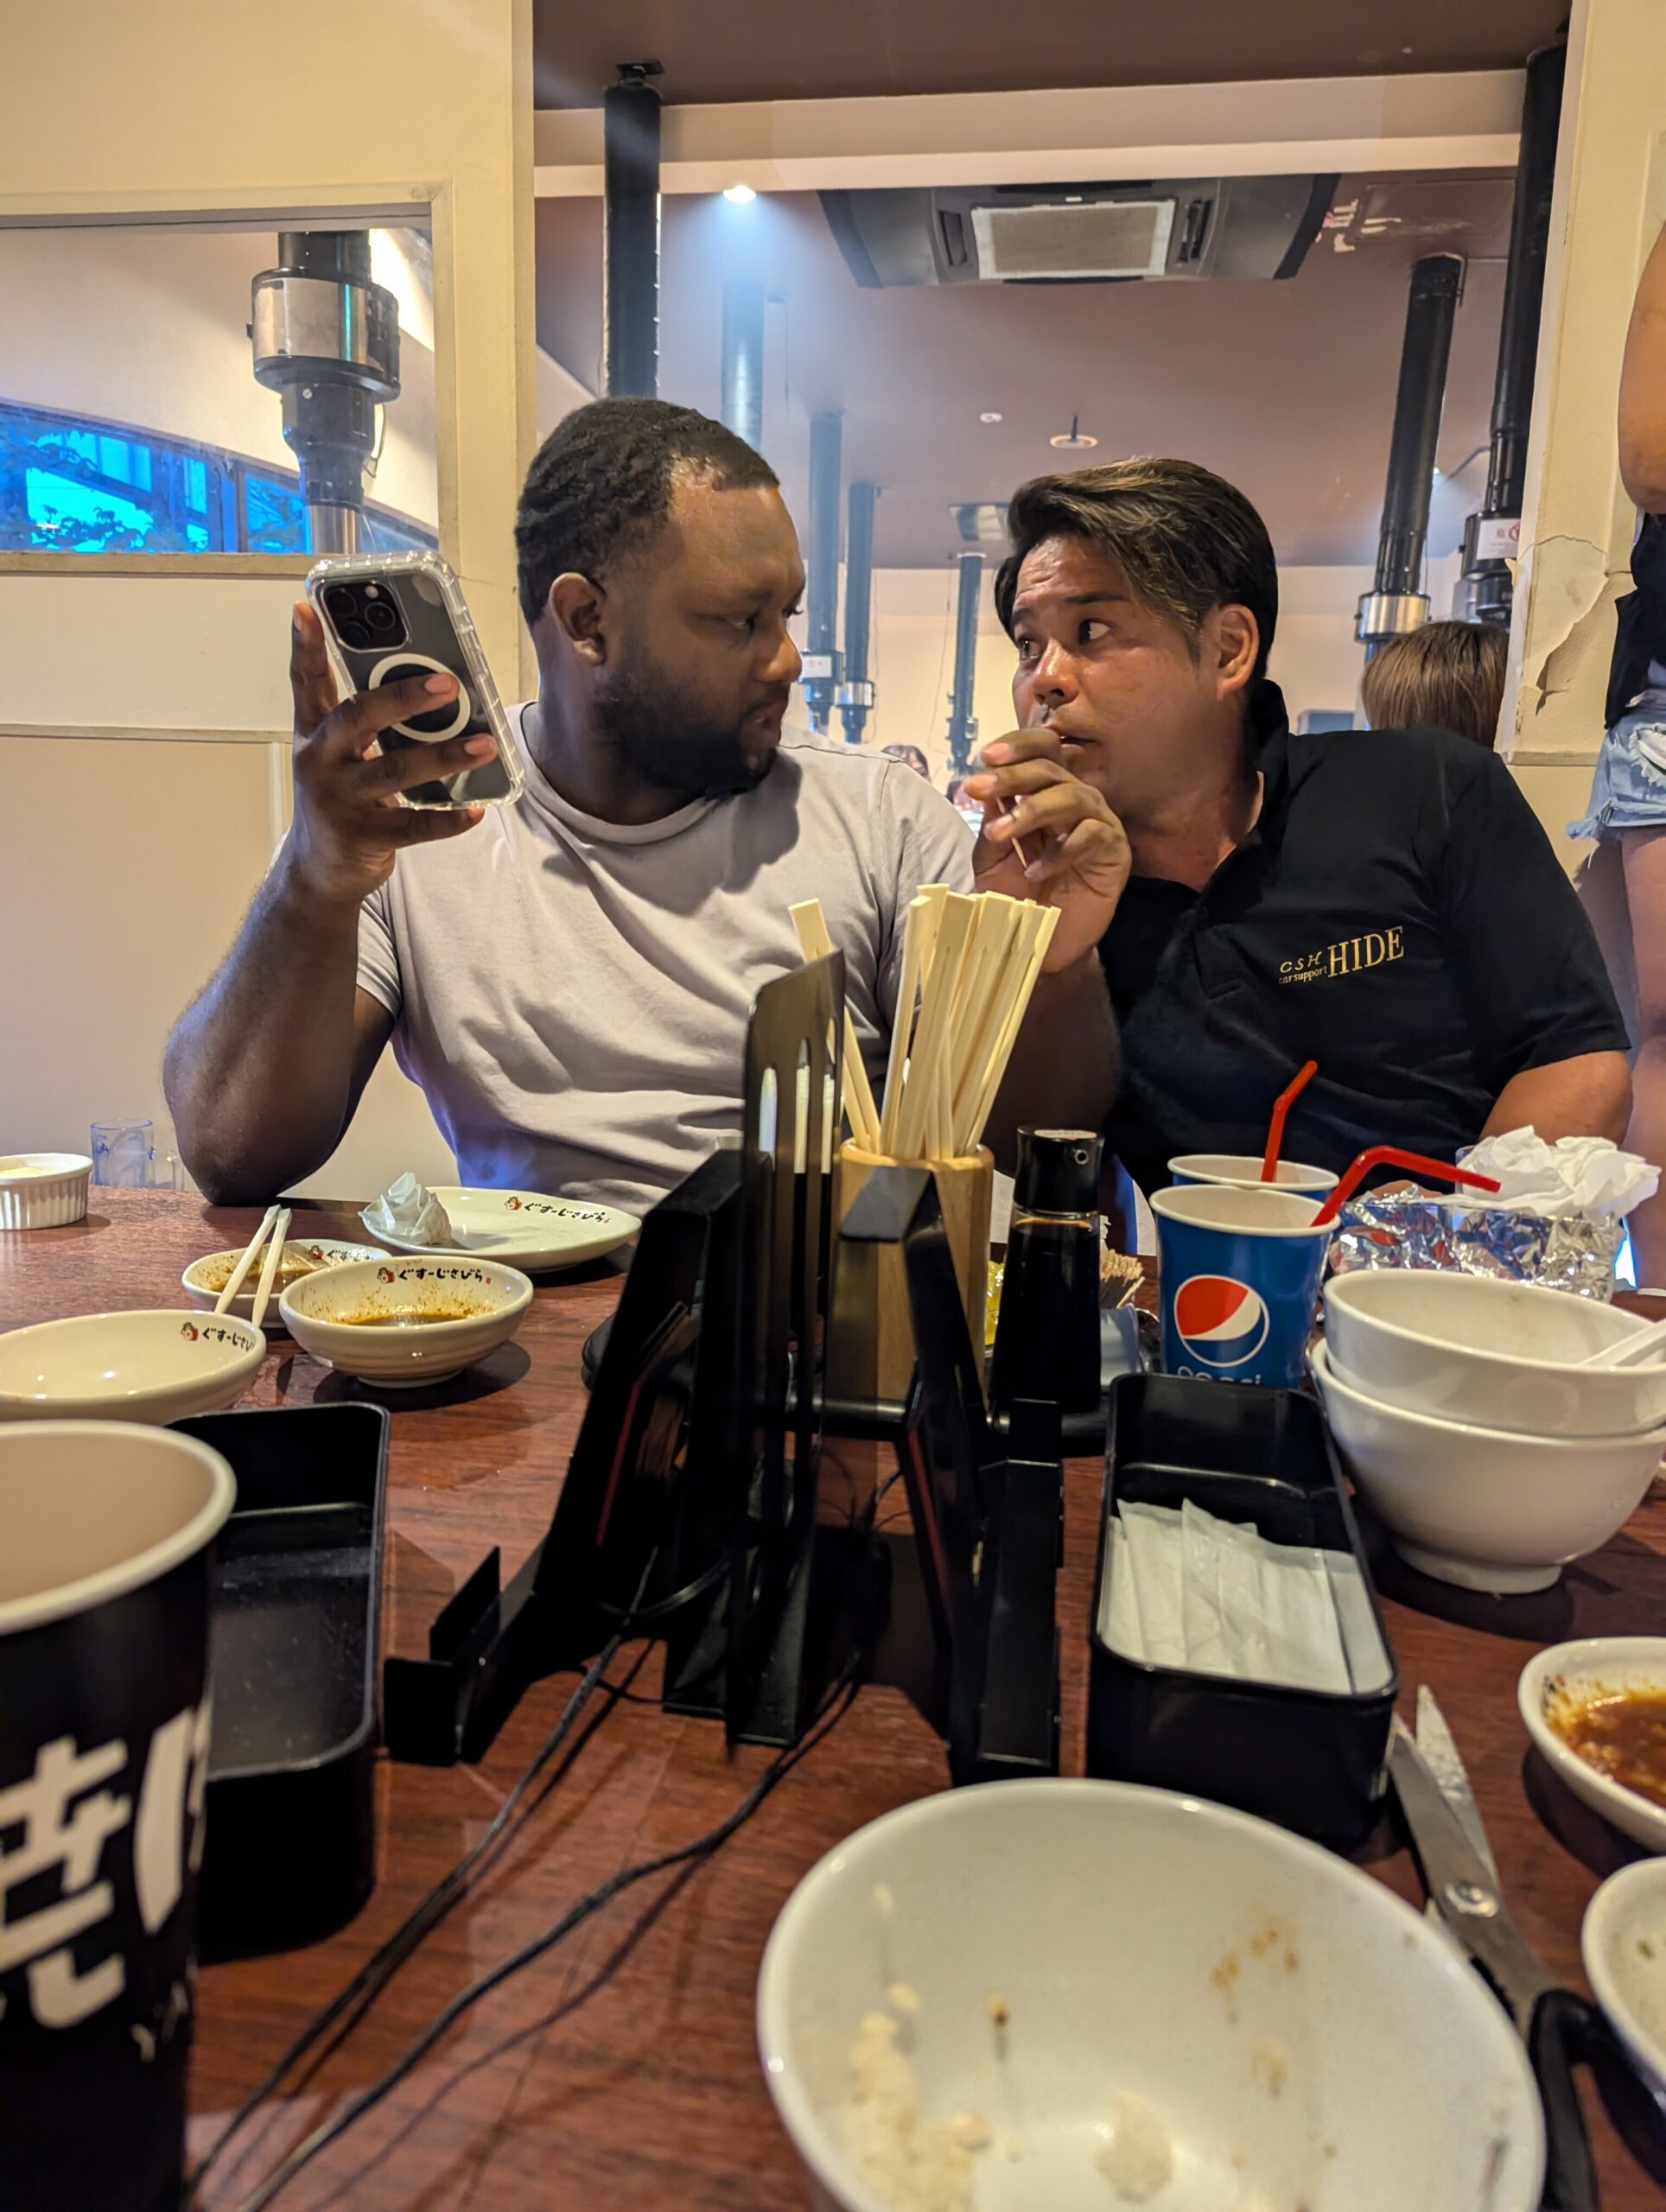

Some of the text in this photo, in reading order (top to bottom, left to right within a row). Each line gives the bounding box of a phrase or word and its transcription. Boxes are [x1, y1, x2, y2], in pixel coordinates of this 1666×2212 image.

[1327, 925, 1404, 978] HIDE
[398, 1268, 483, 1283] ぐすーじさびら
